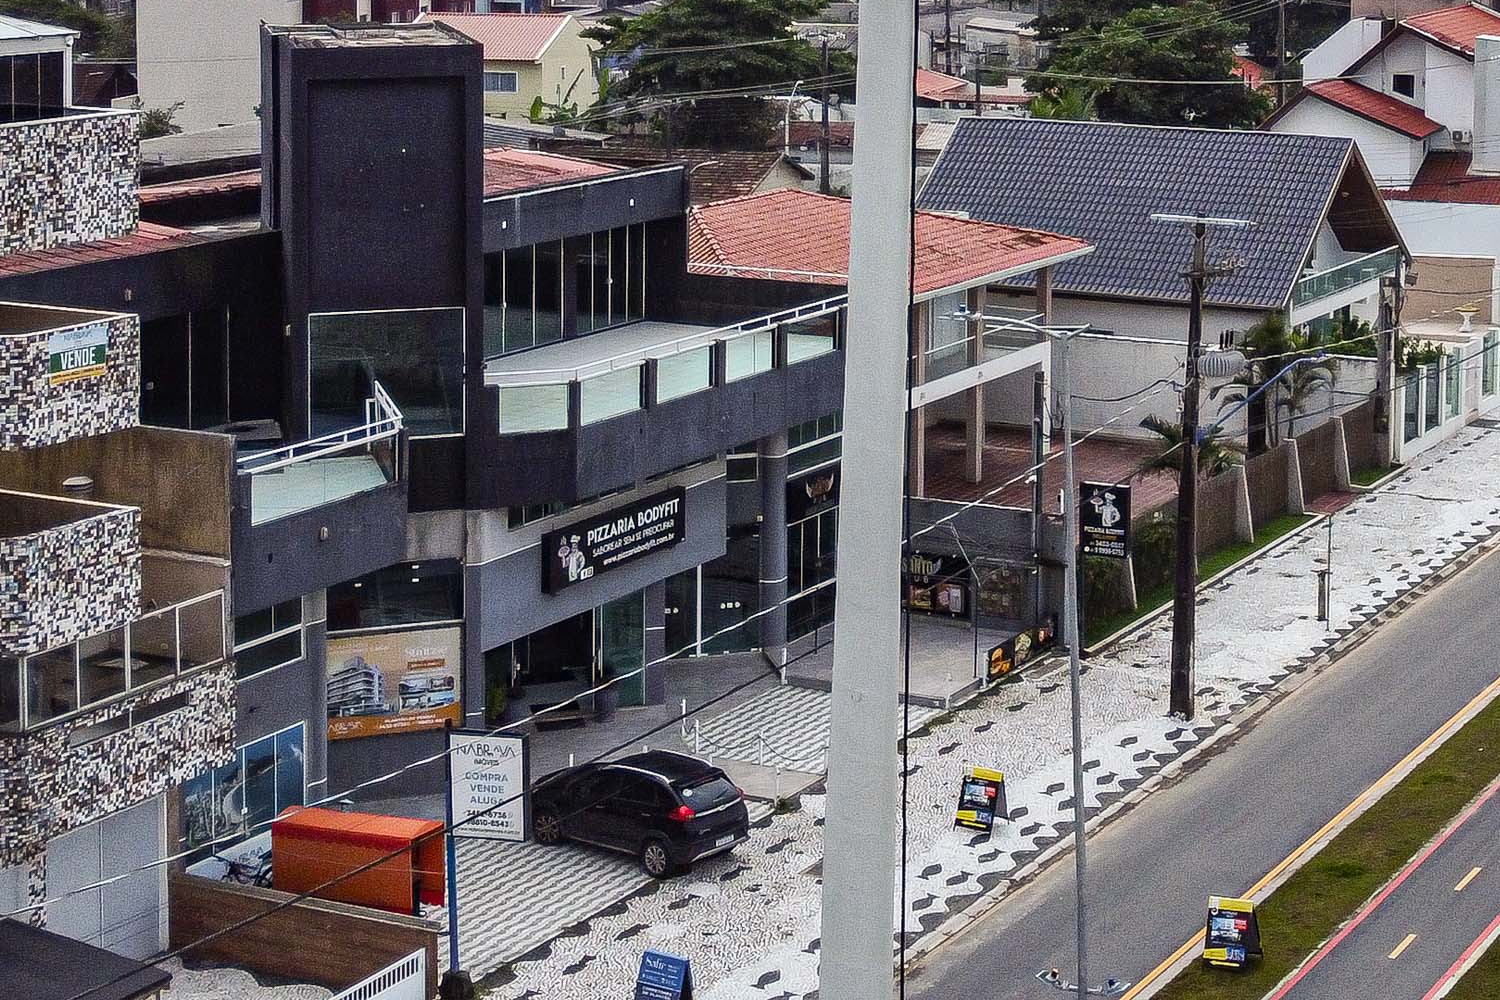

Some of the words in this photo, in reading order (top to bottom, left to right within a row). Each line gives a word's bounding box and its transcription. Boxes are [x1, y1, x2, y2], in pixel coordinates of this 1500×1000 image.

[60, 347, 96, 370] VENDE
[587, 515, 635, 546] PIZZARIA
[637, 498, 680, 526] BODYFIT
[592, 539, 622, 558] SABOREAR
[623, 535, 635, 546] SEM
[635, 532, 642, 541] SE
[642, 519, 675, 539] PREOCUPAR
[456, 743, 516, 758] NABRAVA
[465, 771, 508, 782] COMPRA
[469, 784, 505, 794] VENDE
